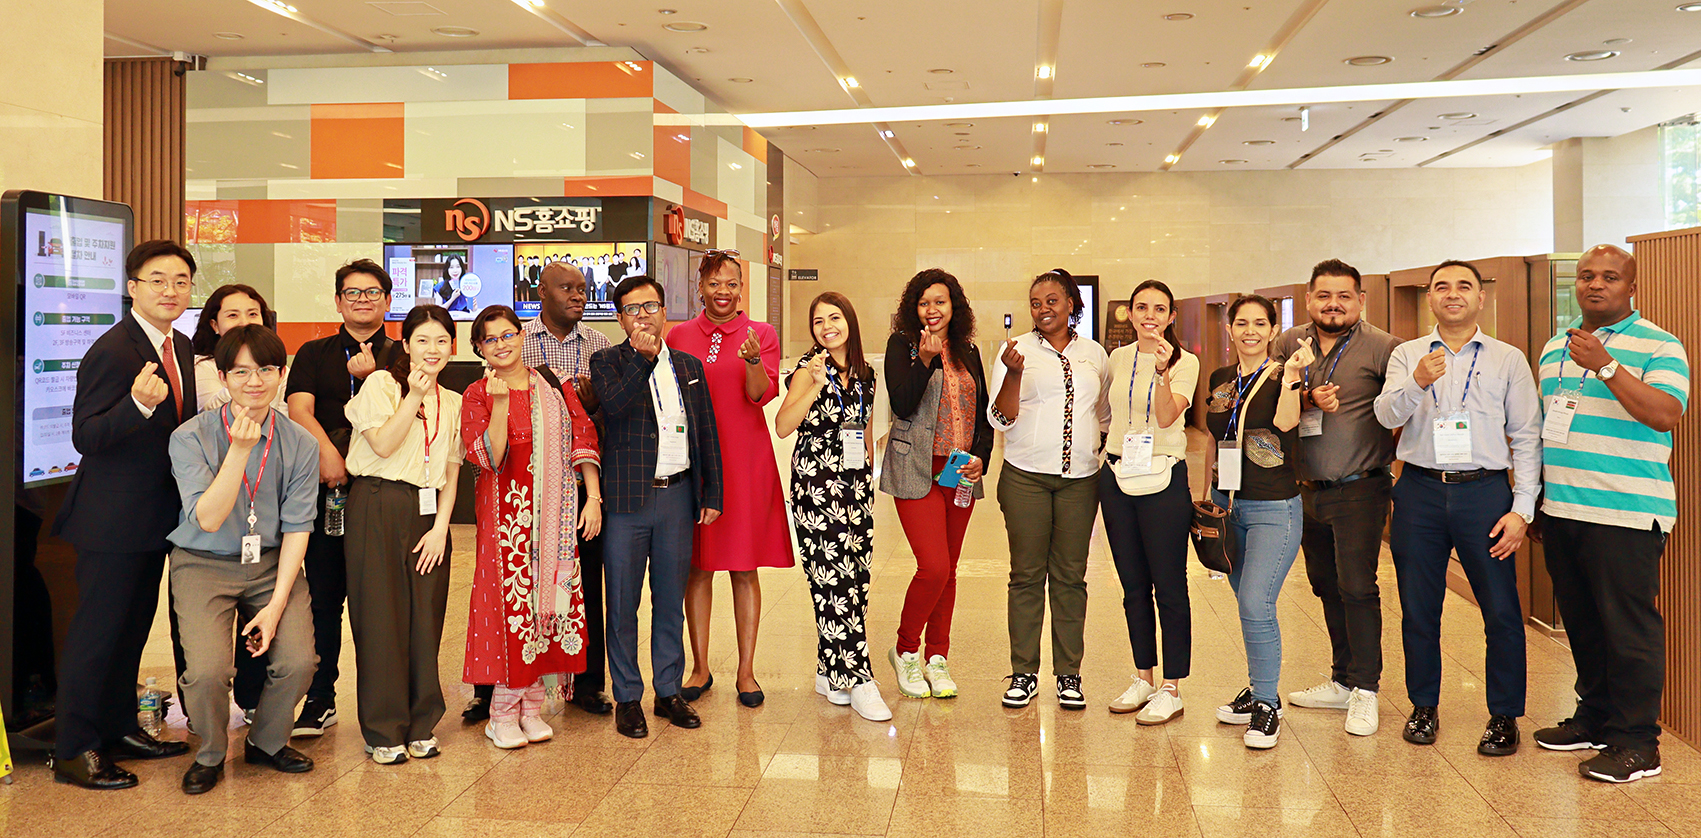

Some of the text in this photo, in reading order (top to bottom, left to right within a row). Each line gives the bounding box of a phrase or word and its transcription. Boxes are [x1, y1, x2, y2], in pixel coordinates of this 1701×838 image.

[494, 207, 597, 233] NS홈쇼핑
[84, 251, 96, 261] 안내
[392, 267, 407, 276] 파격
[392, 278, 407, 287] 특가
